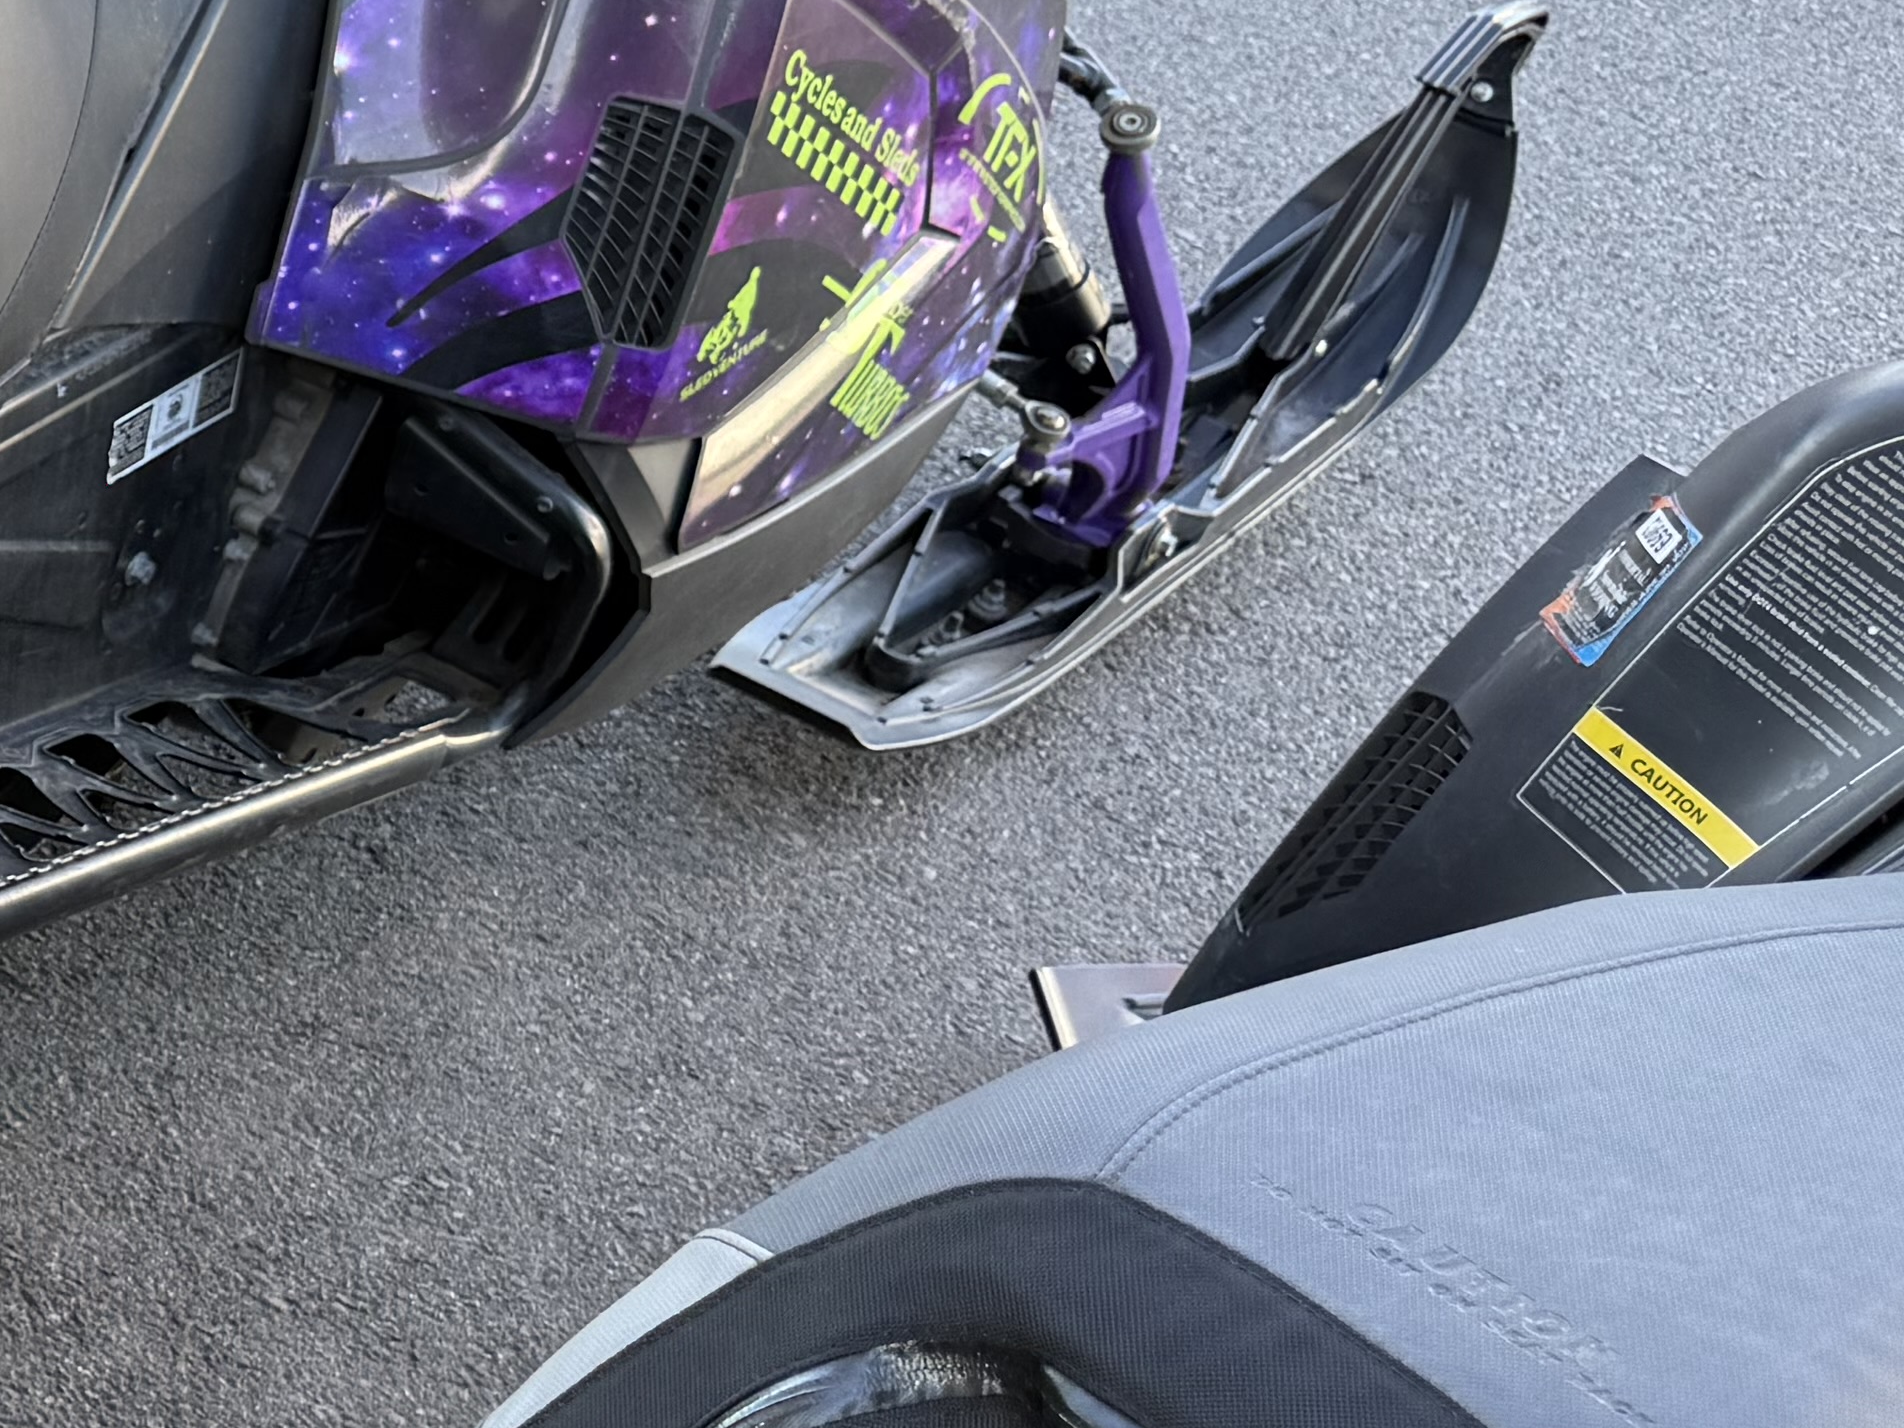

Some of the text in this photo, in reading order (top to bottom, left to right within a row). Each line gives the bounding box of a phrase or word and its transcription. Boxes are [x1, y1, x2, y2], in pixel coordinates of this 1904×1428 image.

[785, 49, 920, 188] Cycles and Sleds
[983, 101, 1037, 203] TFX
[1629, 757, 1710, 826] CAUTION
